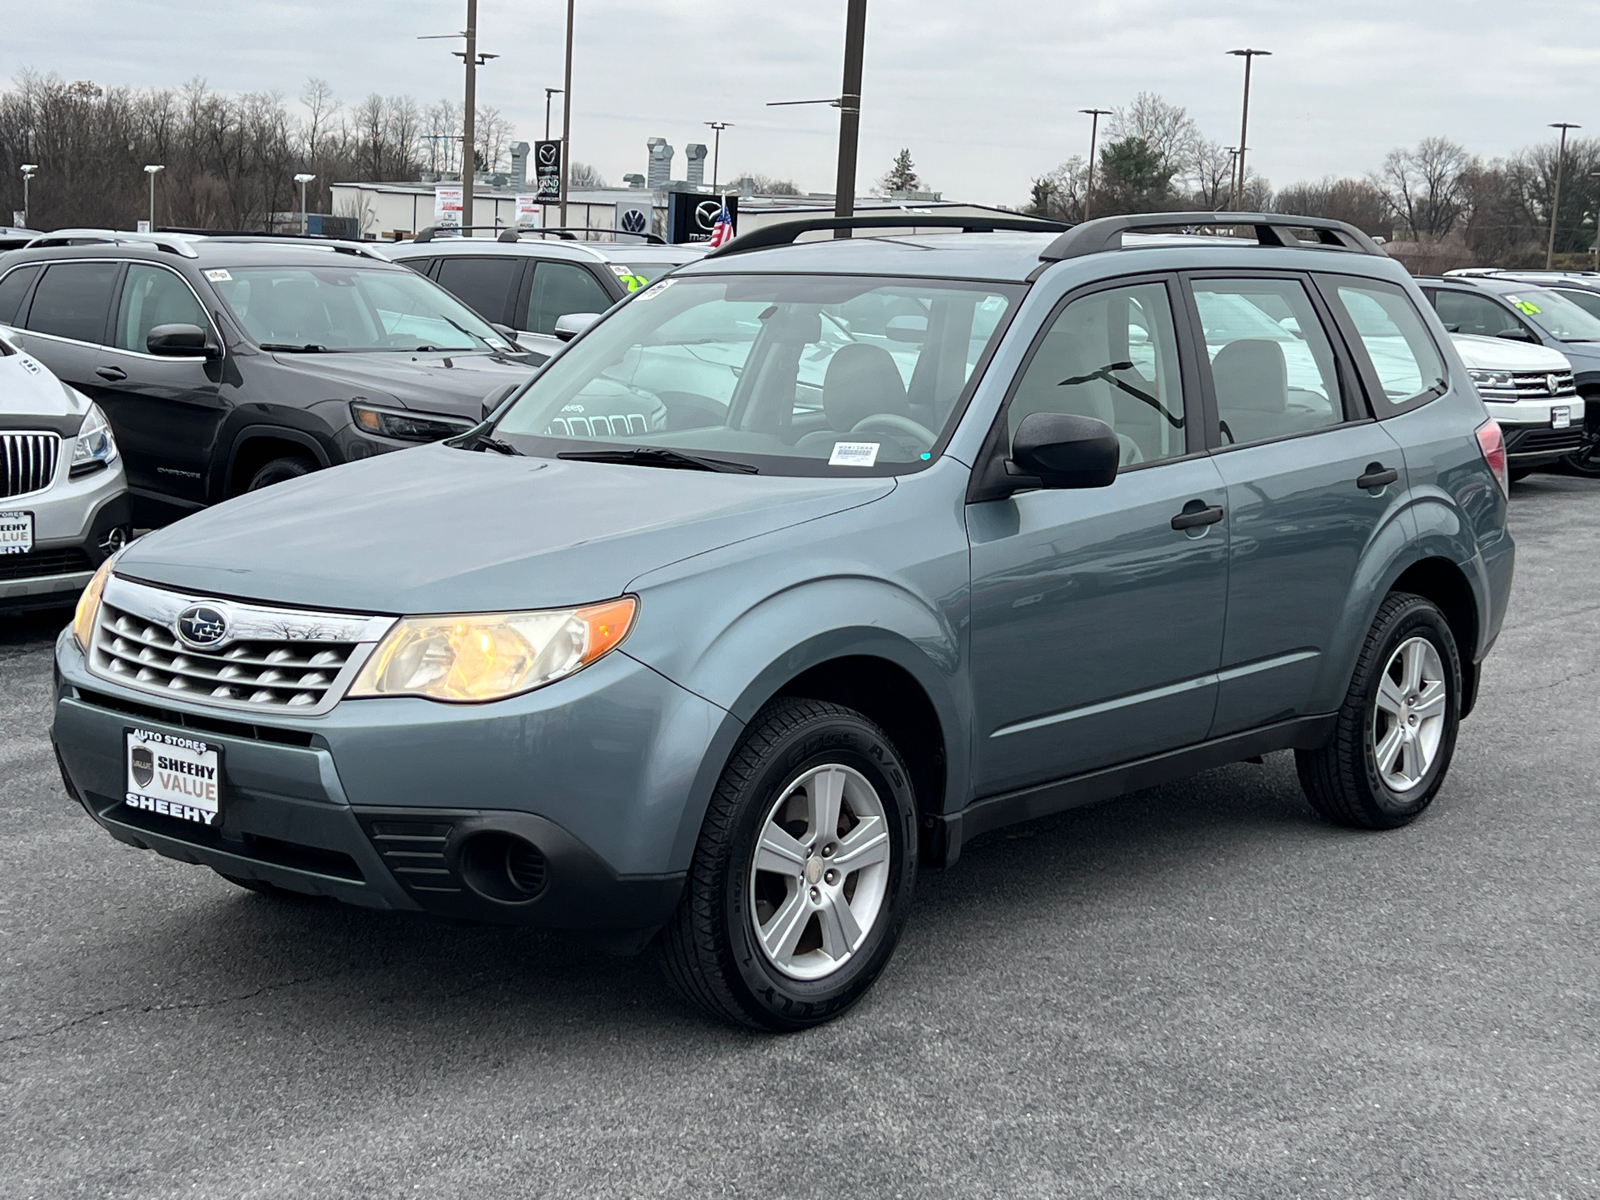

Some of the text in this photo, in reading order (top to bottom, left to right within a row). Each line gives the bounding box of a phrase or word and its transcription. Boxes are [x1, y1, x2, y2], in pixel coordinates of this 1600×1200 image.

[689, 233, 712, 242] maz
[133, 728, 207, 752] AUTO STORES
[157, 755, 215, 780] SHEEHY
[158, 771, 216, 801] VALUE
[125, 793, 217, 825] SHEEHY
